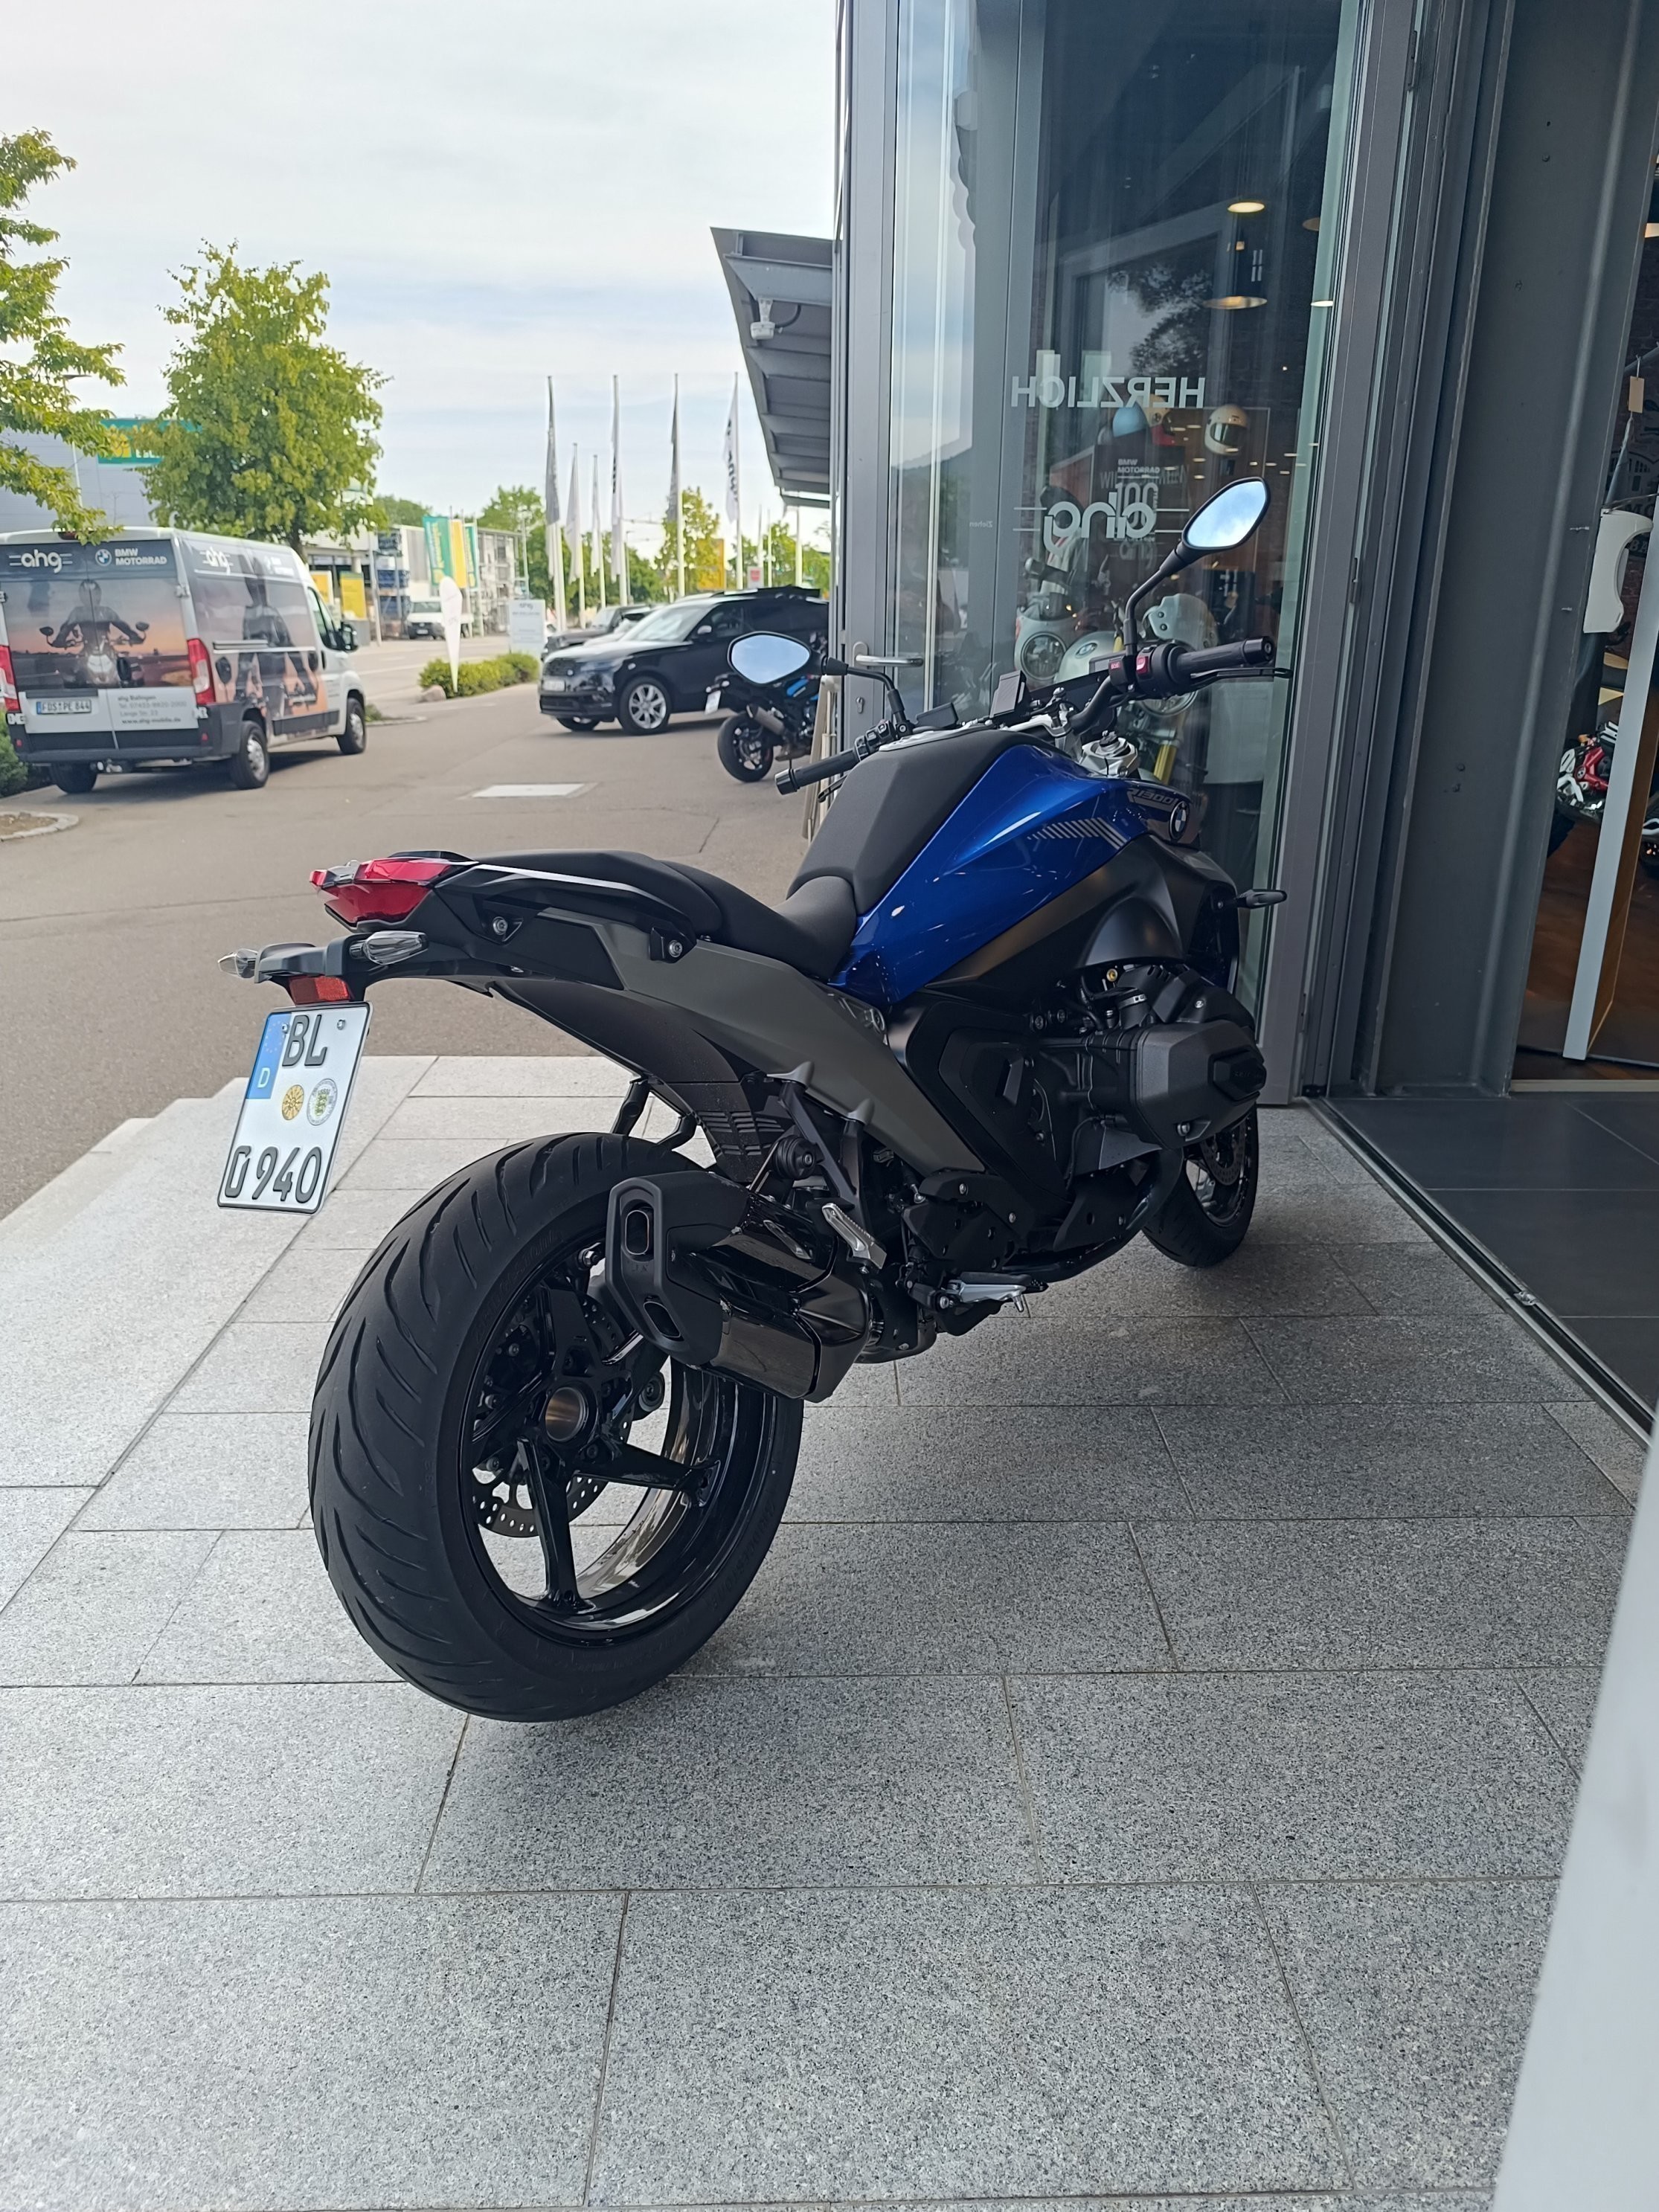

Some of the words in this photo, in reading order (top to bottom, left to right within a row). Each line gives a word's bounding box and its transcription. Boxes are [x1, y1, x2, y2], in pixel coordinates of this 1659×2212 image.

[1117, 458, 1138, 466] BMW
[21, 549, 62, 573] ahg
[115, 548, 138, 556] BMW
[115, 556, 167, 566] MOTORRAD
[282, 1014, 328, 1067] BL
[257, 1067, 271, 1089] D
[251, 1146, 322, 1204] 940
